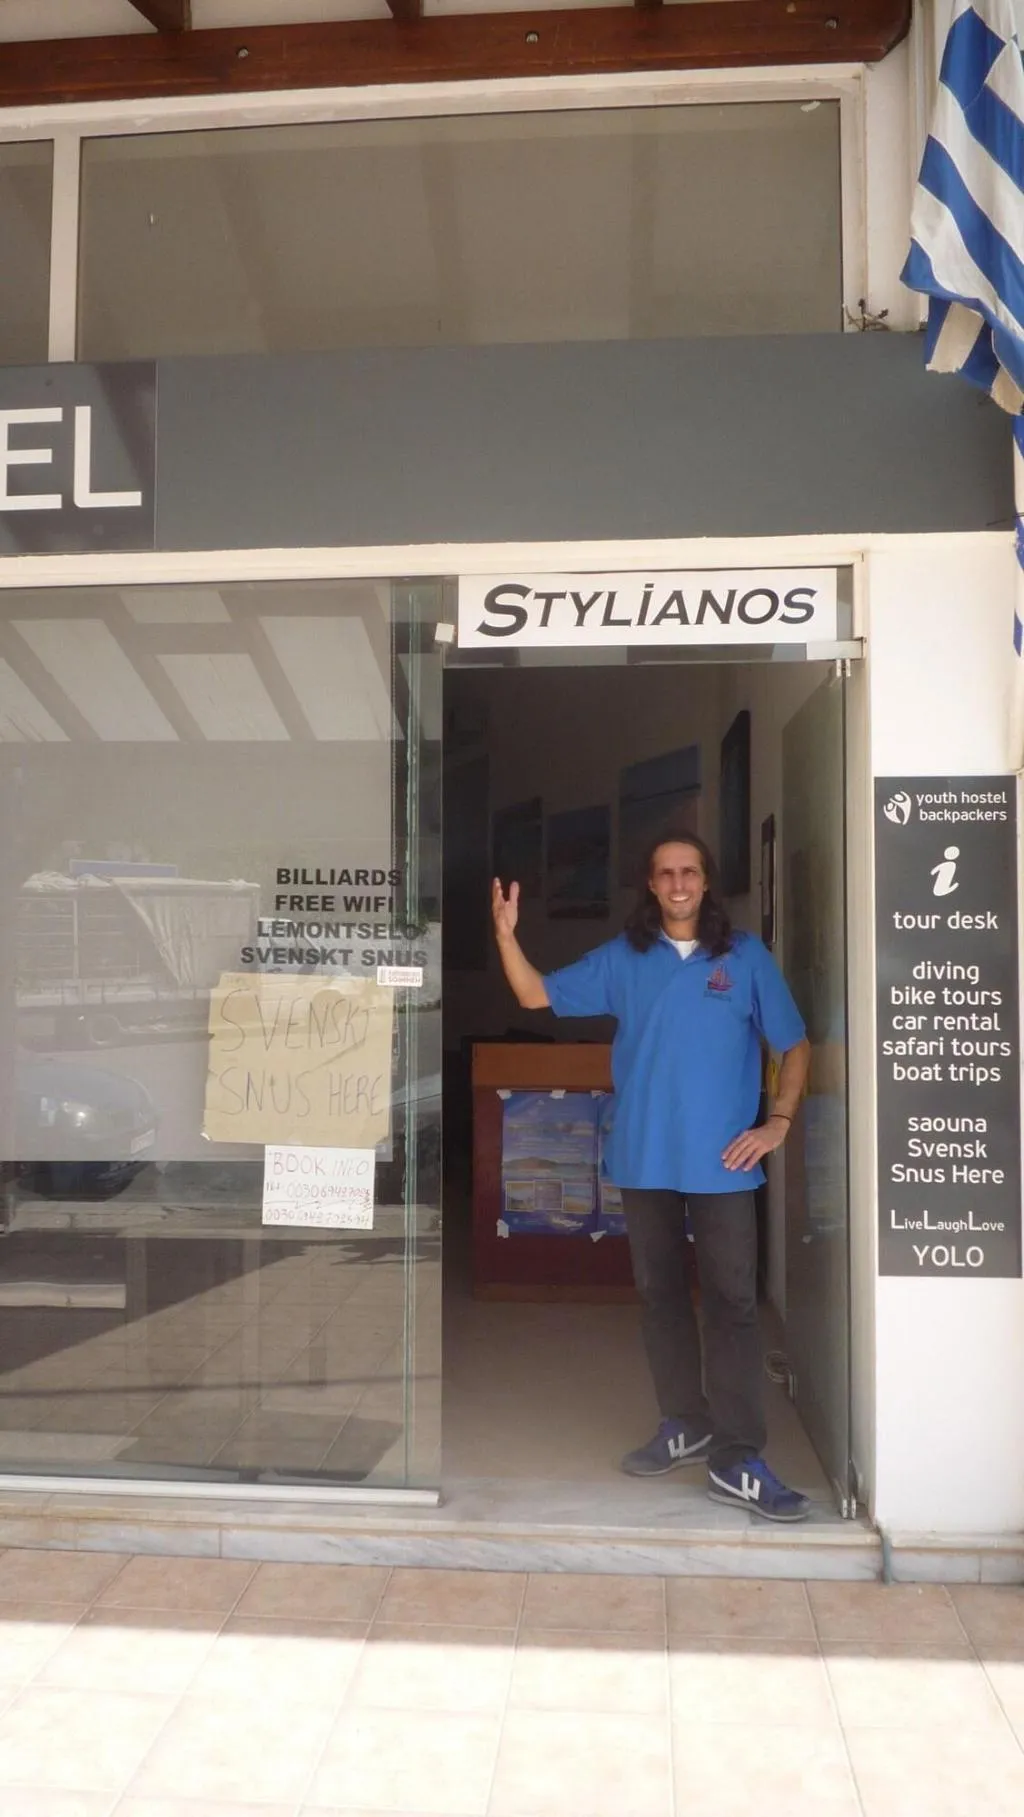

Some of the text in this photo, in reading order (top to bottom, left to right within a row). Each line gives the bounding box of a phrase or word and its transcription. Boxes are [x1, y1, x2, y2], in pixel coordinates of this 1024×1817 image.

[0, 405, 142, 511] EL
[916, 791, 1007, 806] youth hostel
[920, 808, 1007, 823] backpackers
[276, 868, 401, 886] BILLIARDS
[275, 895, 394, 912] FREE WIFI
[893, 910, 999, 929] tour desk
[257, 920, 421, 940] LEMONTSELO
[240, 946, 428, 966] SVENSKT SNUS
[912, 960, 980, 984] diving
[891, 986, 1003, 1005] bike tours
[220, 988, 377, 1051] SVENSKT
[892, 1012, 1001, 1031] car rental
[882, 1037, 1012, 1056] safari tours
[893, 1062, 1002, 1086] boat trips
[219, 1066, 385, 1118] SNUS HERE
[908, 1116, 988, 1132] saouna
[908, 1138, 988, 1158] Svensk
[272, 1152, 326, 1176] BOOK
[891, 1163, 1005, 1184] Snus Here
[912, 1245, 985, 1267] YOLO
